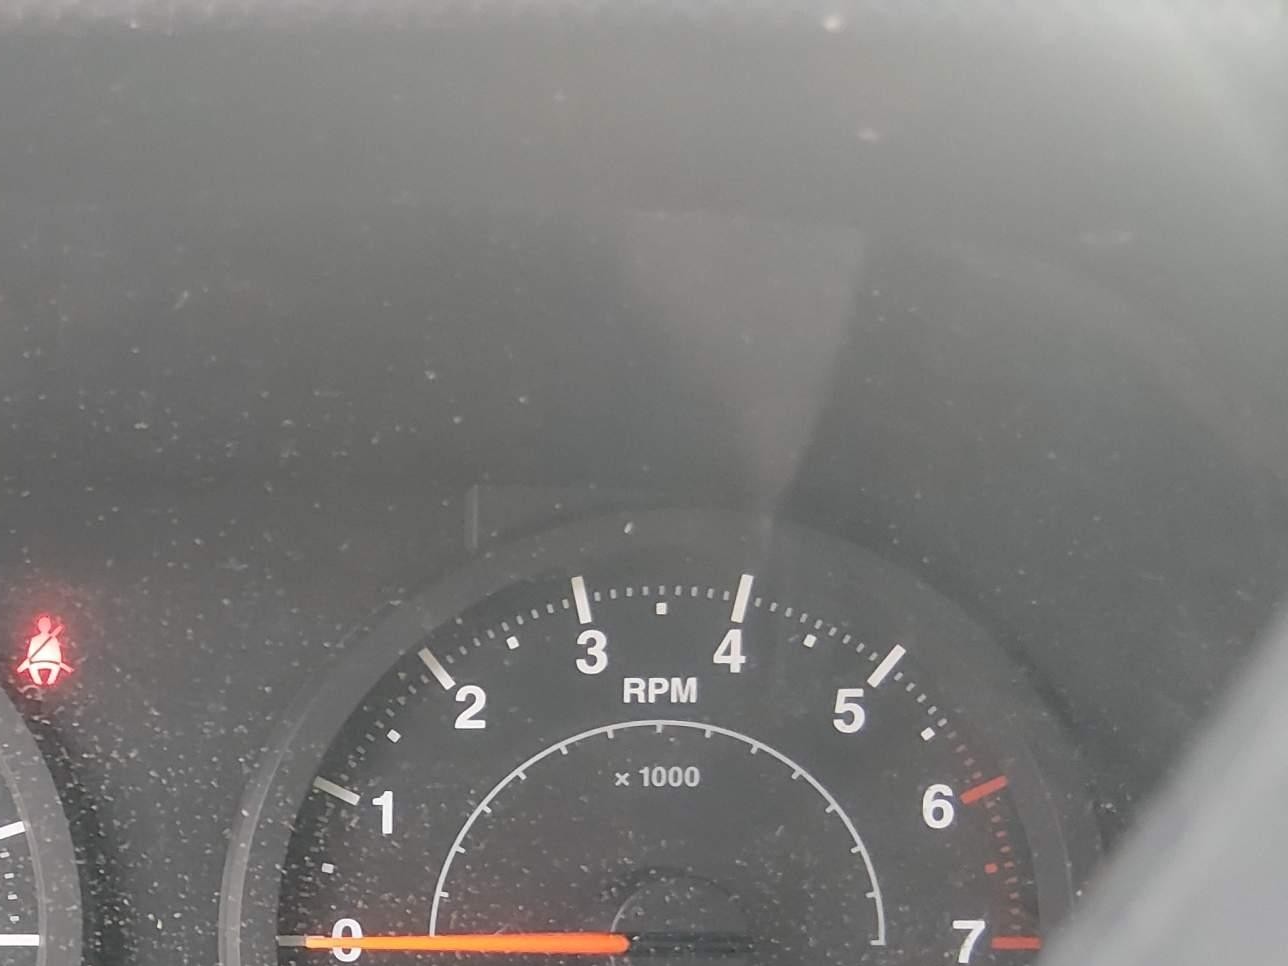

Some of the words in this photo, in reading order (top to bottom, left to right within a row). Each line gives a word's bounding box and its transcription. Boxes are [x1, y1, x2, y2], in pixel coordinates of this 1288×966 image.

[576, 631, 608, 674] 3
[713, 629, 745, 673] 4
[454, 687, 486, 729] 2
[623, 678, 698, 704] RPM
[833, 689, 865, 733] 5
[639, 767, 700, 788] 1000
[373, 792, 394, 833] 1
[923, 785, 955, 828] 6
[332, 919, 362, 961] 0
[954, 920, 986, 963] 7
